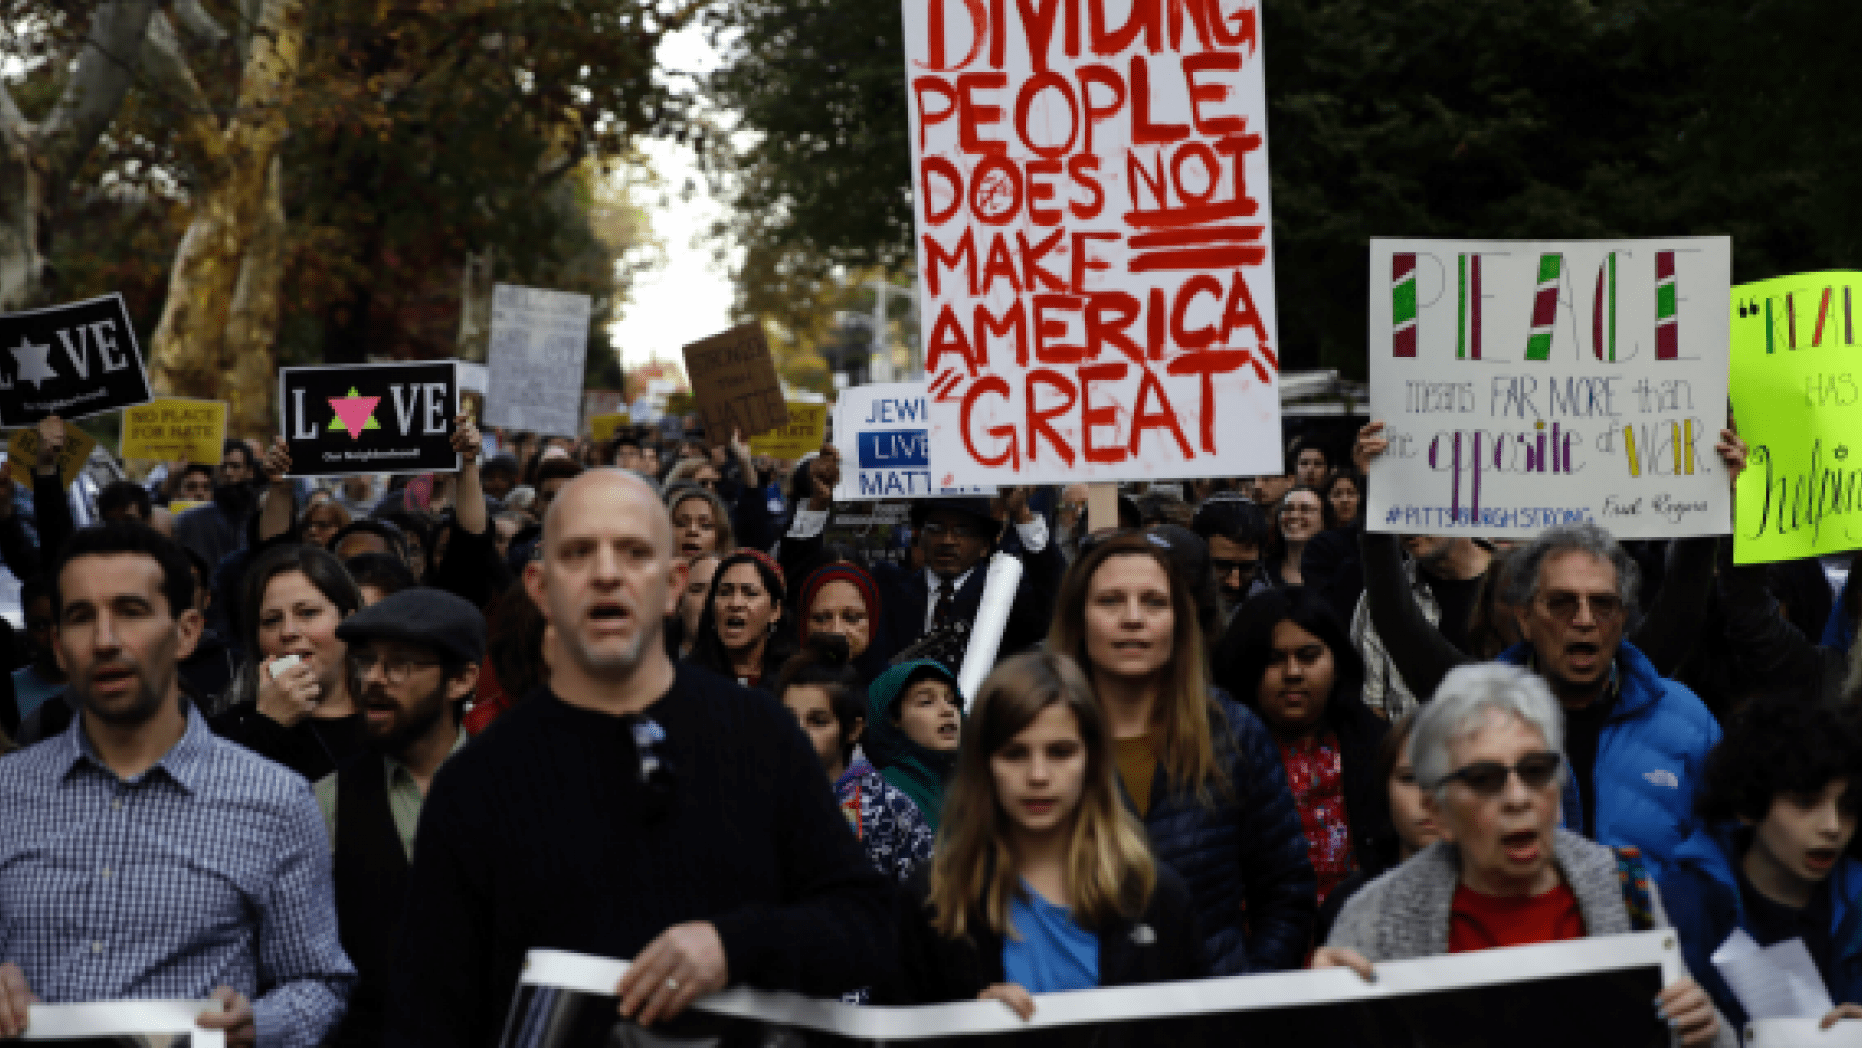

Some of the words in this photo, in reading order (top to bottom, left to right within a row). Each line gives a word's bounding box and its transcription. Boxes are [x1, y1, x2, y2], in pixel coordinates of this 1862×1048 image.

[911, 0, 1257, 73] DIVIDING
[912, 52, 1249, 158] PEOPLE
[921, 153, 1106, 227] DOES
[1126, 133, 1262, 214] NOT
[921, 224, 1123, 296] MAKE
[925, 270, 1268, 376] AMERICA
[1391, 250, 1702, 363] PEACE
[131, 410, 159, 424] NO
[161, 408, 216, 424] PLACE
[865, 398, 928, 423] JEWI
[1405, 379, 1476, 414] means
[1490, 374, 1541, 419] FAR
[1549, 374, 1623, 419] MORE
[1630, 376, 1695, 414] than
[1805, 372, 1858, 407] HAS
[131, 425, 163, 440] FOR
[170, 425, 214, 440] HATE
[1428, 418, 1587, 523] opposite
